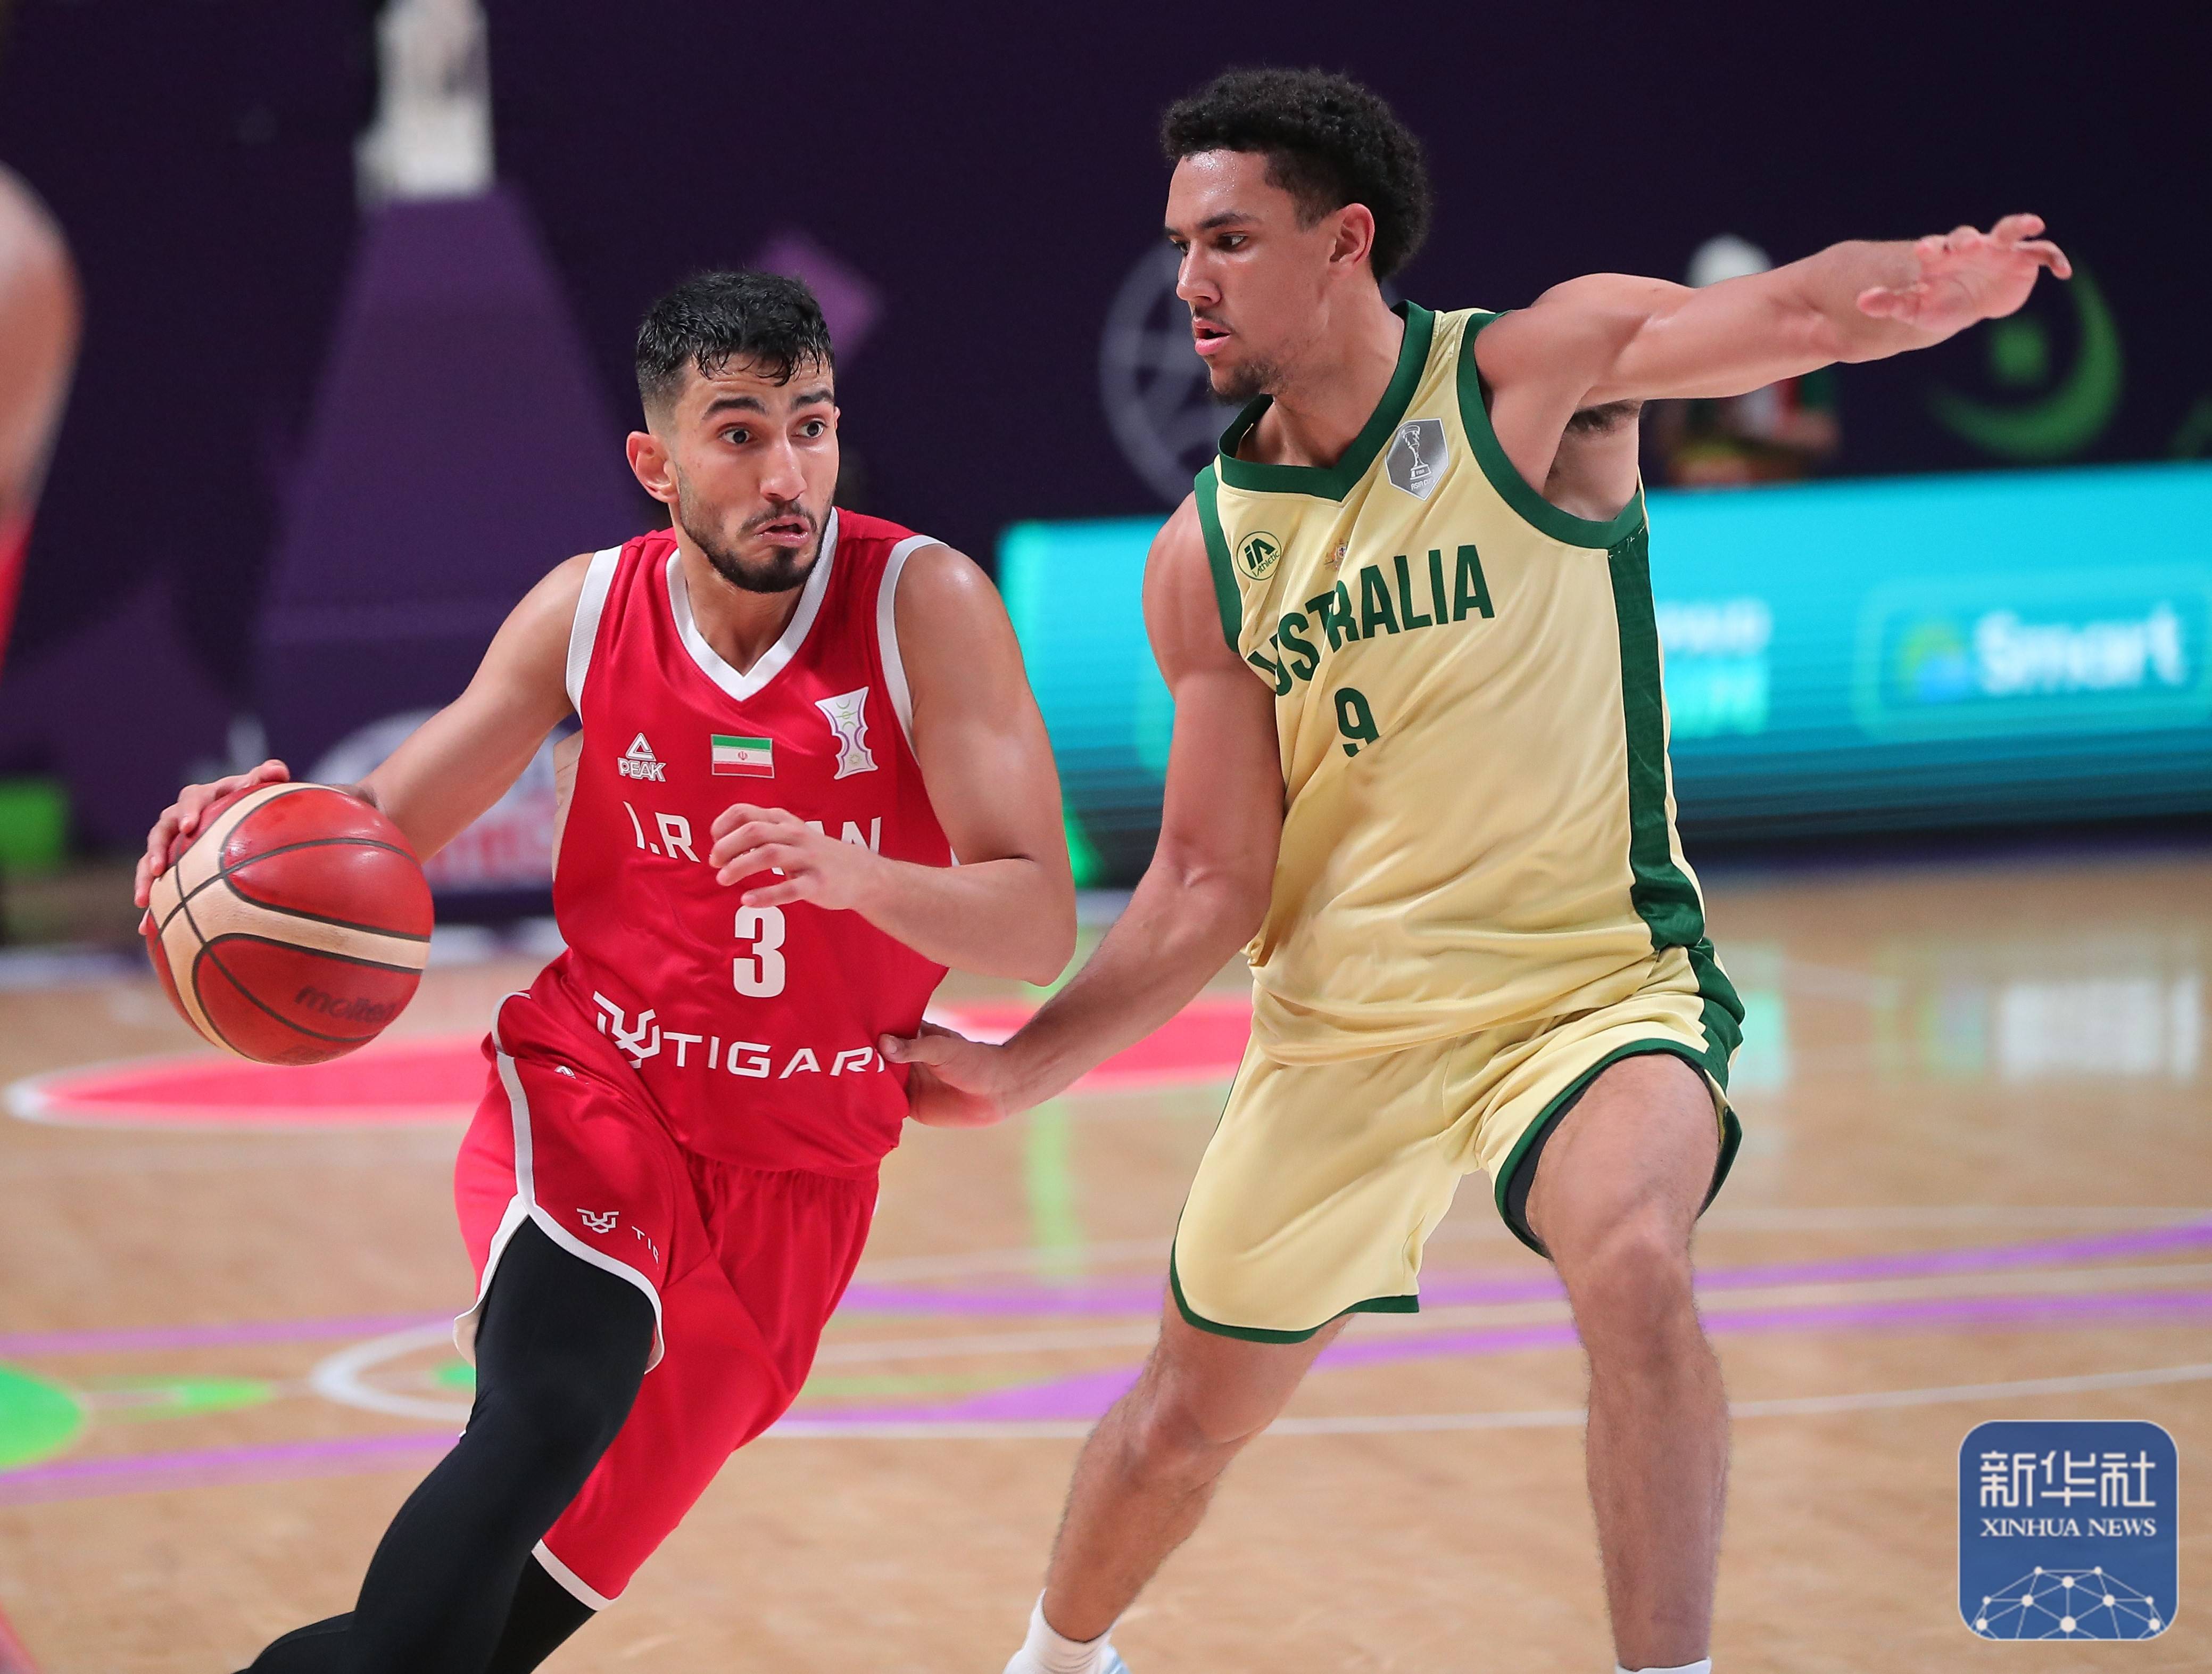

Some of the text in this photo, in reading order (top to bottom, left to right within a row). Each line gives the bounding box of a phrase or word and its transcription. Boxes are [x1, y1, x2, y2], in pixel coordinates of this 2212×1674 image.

[1246, 545, 1495, 697] USTRALIA
[1334, 688, 1380, 757] 9
[617, 757, 667, 782] PEAK
[733, 905, 786, 998] 3
